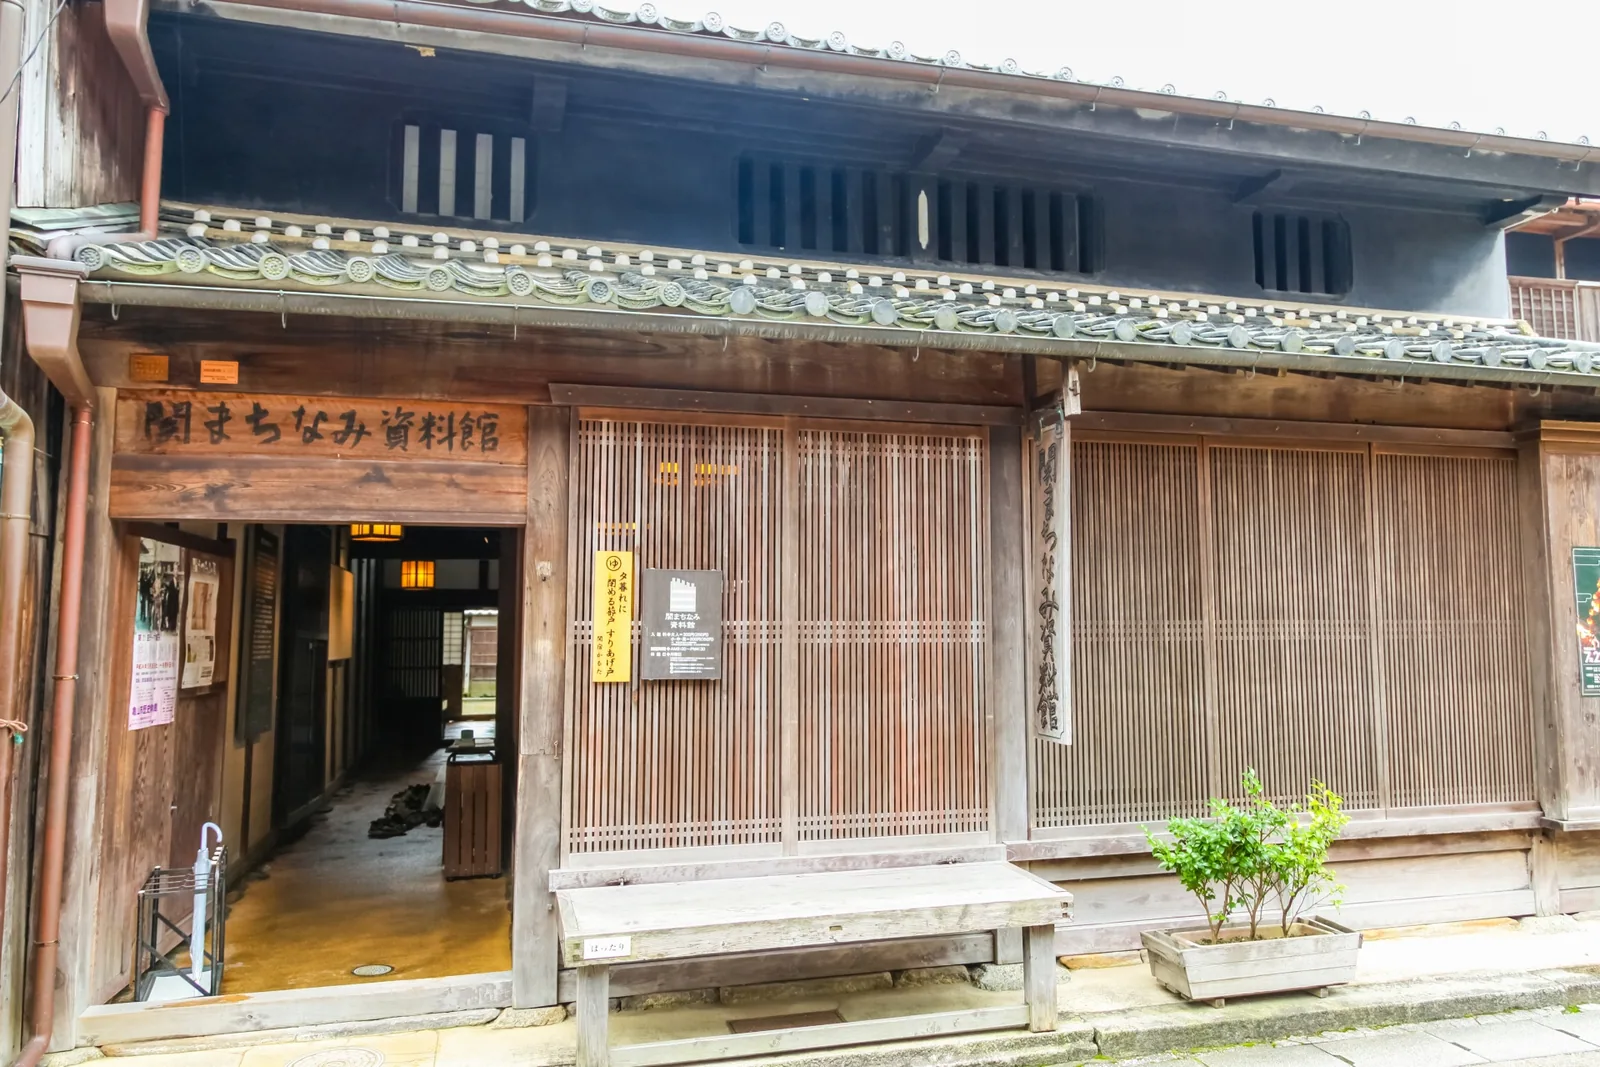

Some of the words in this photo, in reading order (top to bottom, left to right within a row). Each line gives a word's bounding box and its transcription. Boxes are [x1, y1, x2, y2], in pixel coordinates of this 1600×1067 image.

[145, 401, 500, 452] 関まちなみ資料館
[618, 571, 628, 613] 夕暮れに
[664, 612, 701, 621] 関まちなみ
[670, 621, 696, 629] 資料館
